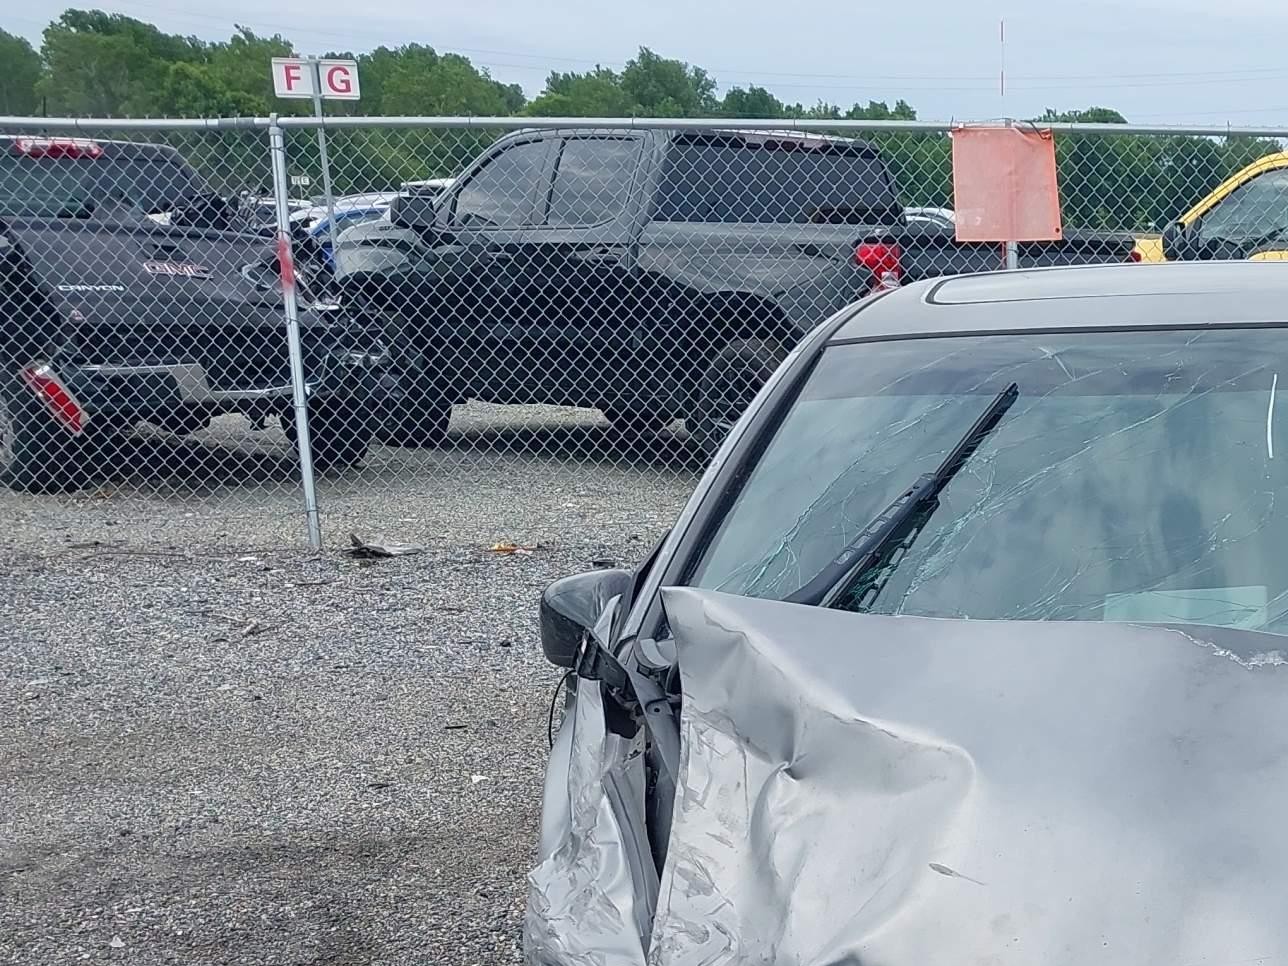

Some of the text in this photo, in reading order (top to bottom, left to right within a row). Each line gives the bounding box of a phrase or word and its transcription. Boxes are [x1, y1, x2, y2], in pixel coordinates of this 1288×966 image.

[284, 65, 352, 93] F G
[143, 261, 214, 280] GMC
